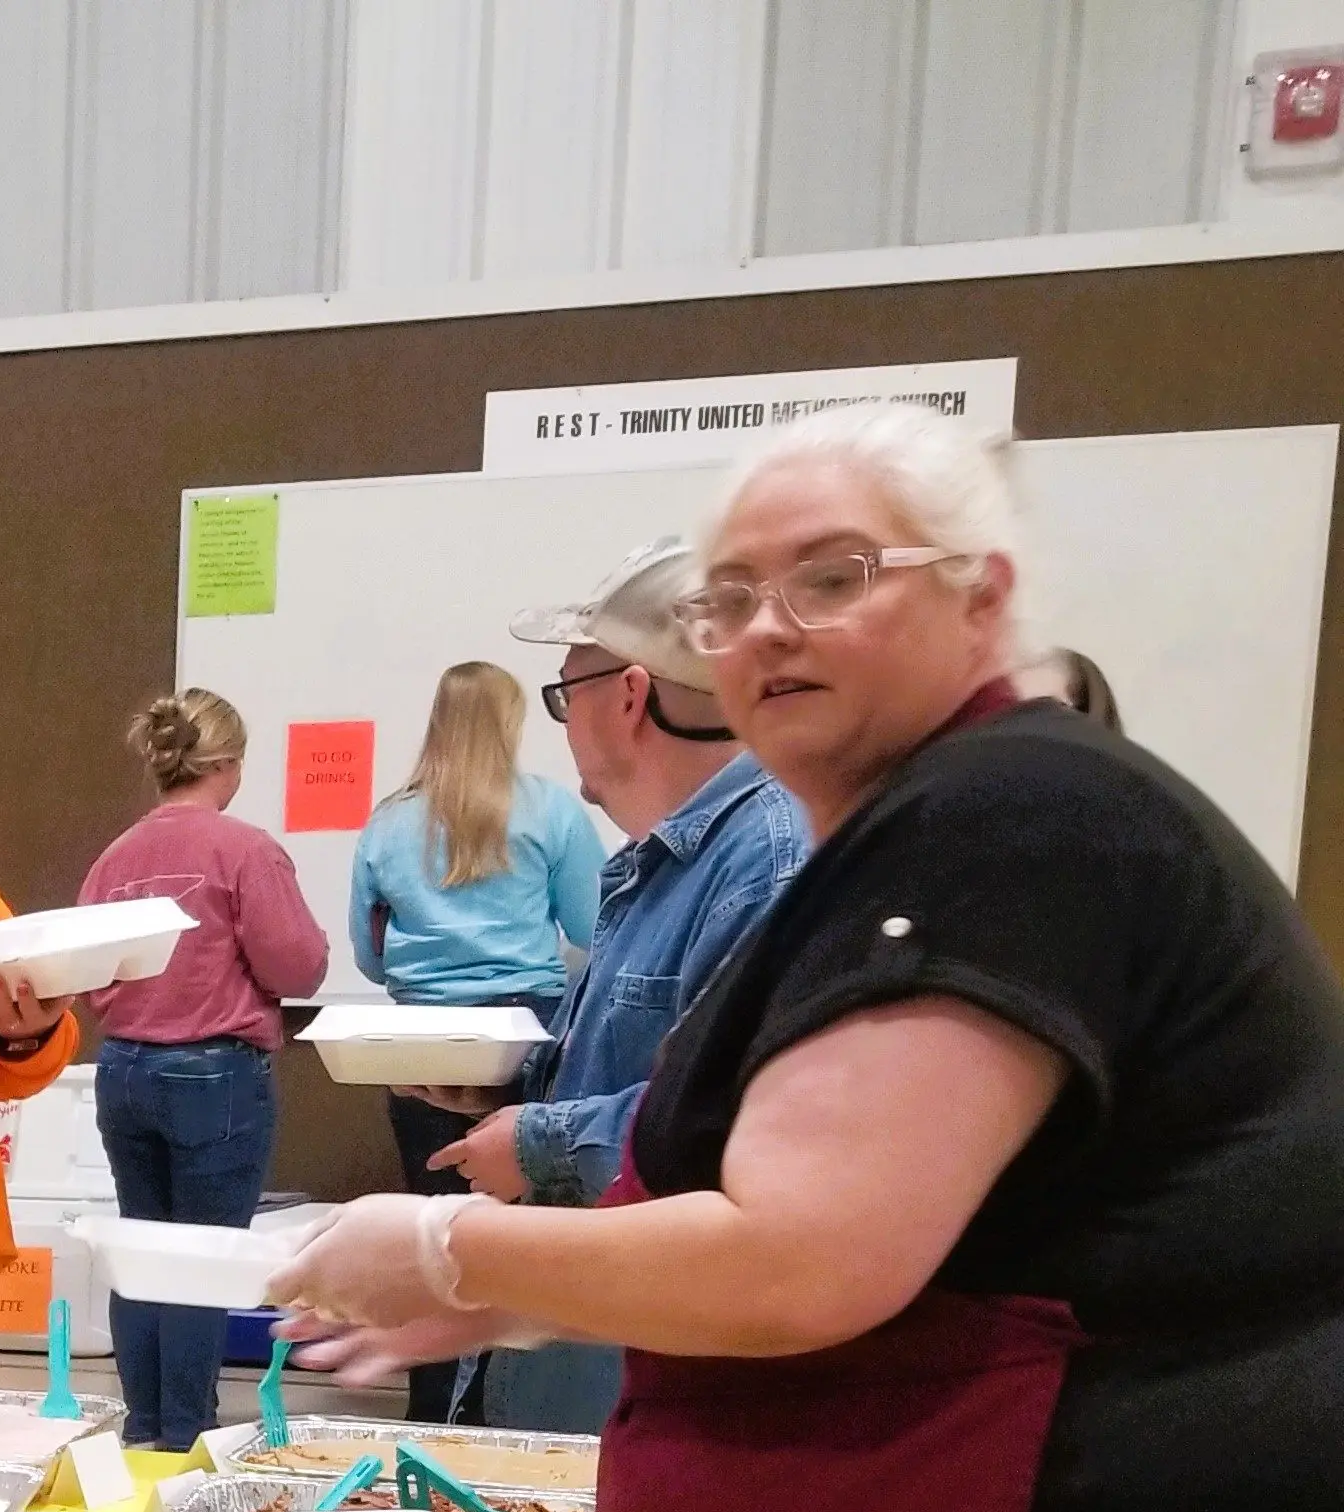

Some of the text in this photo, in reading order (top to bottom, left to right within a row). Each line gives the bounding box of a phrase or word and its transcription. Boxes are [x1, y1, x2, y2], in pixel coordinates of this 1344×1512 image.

[619, 407, 692, 435] TRINITY
[697, 403, 765, 431] UNITED
[889, 391, 966, 416] RCH
[311, 751, 327, 764] TO
[305, 771, 355, 785] DRINKS
[4, 1260, 39, 1275] OKE
